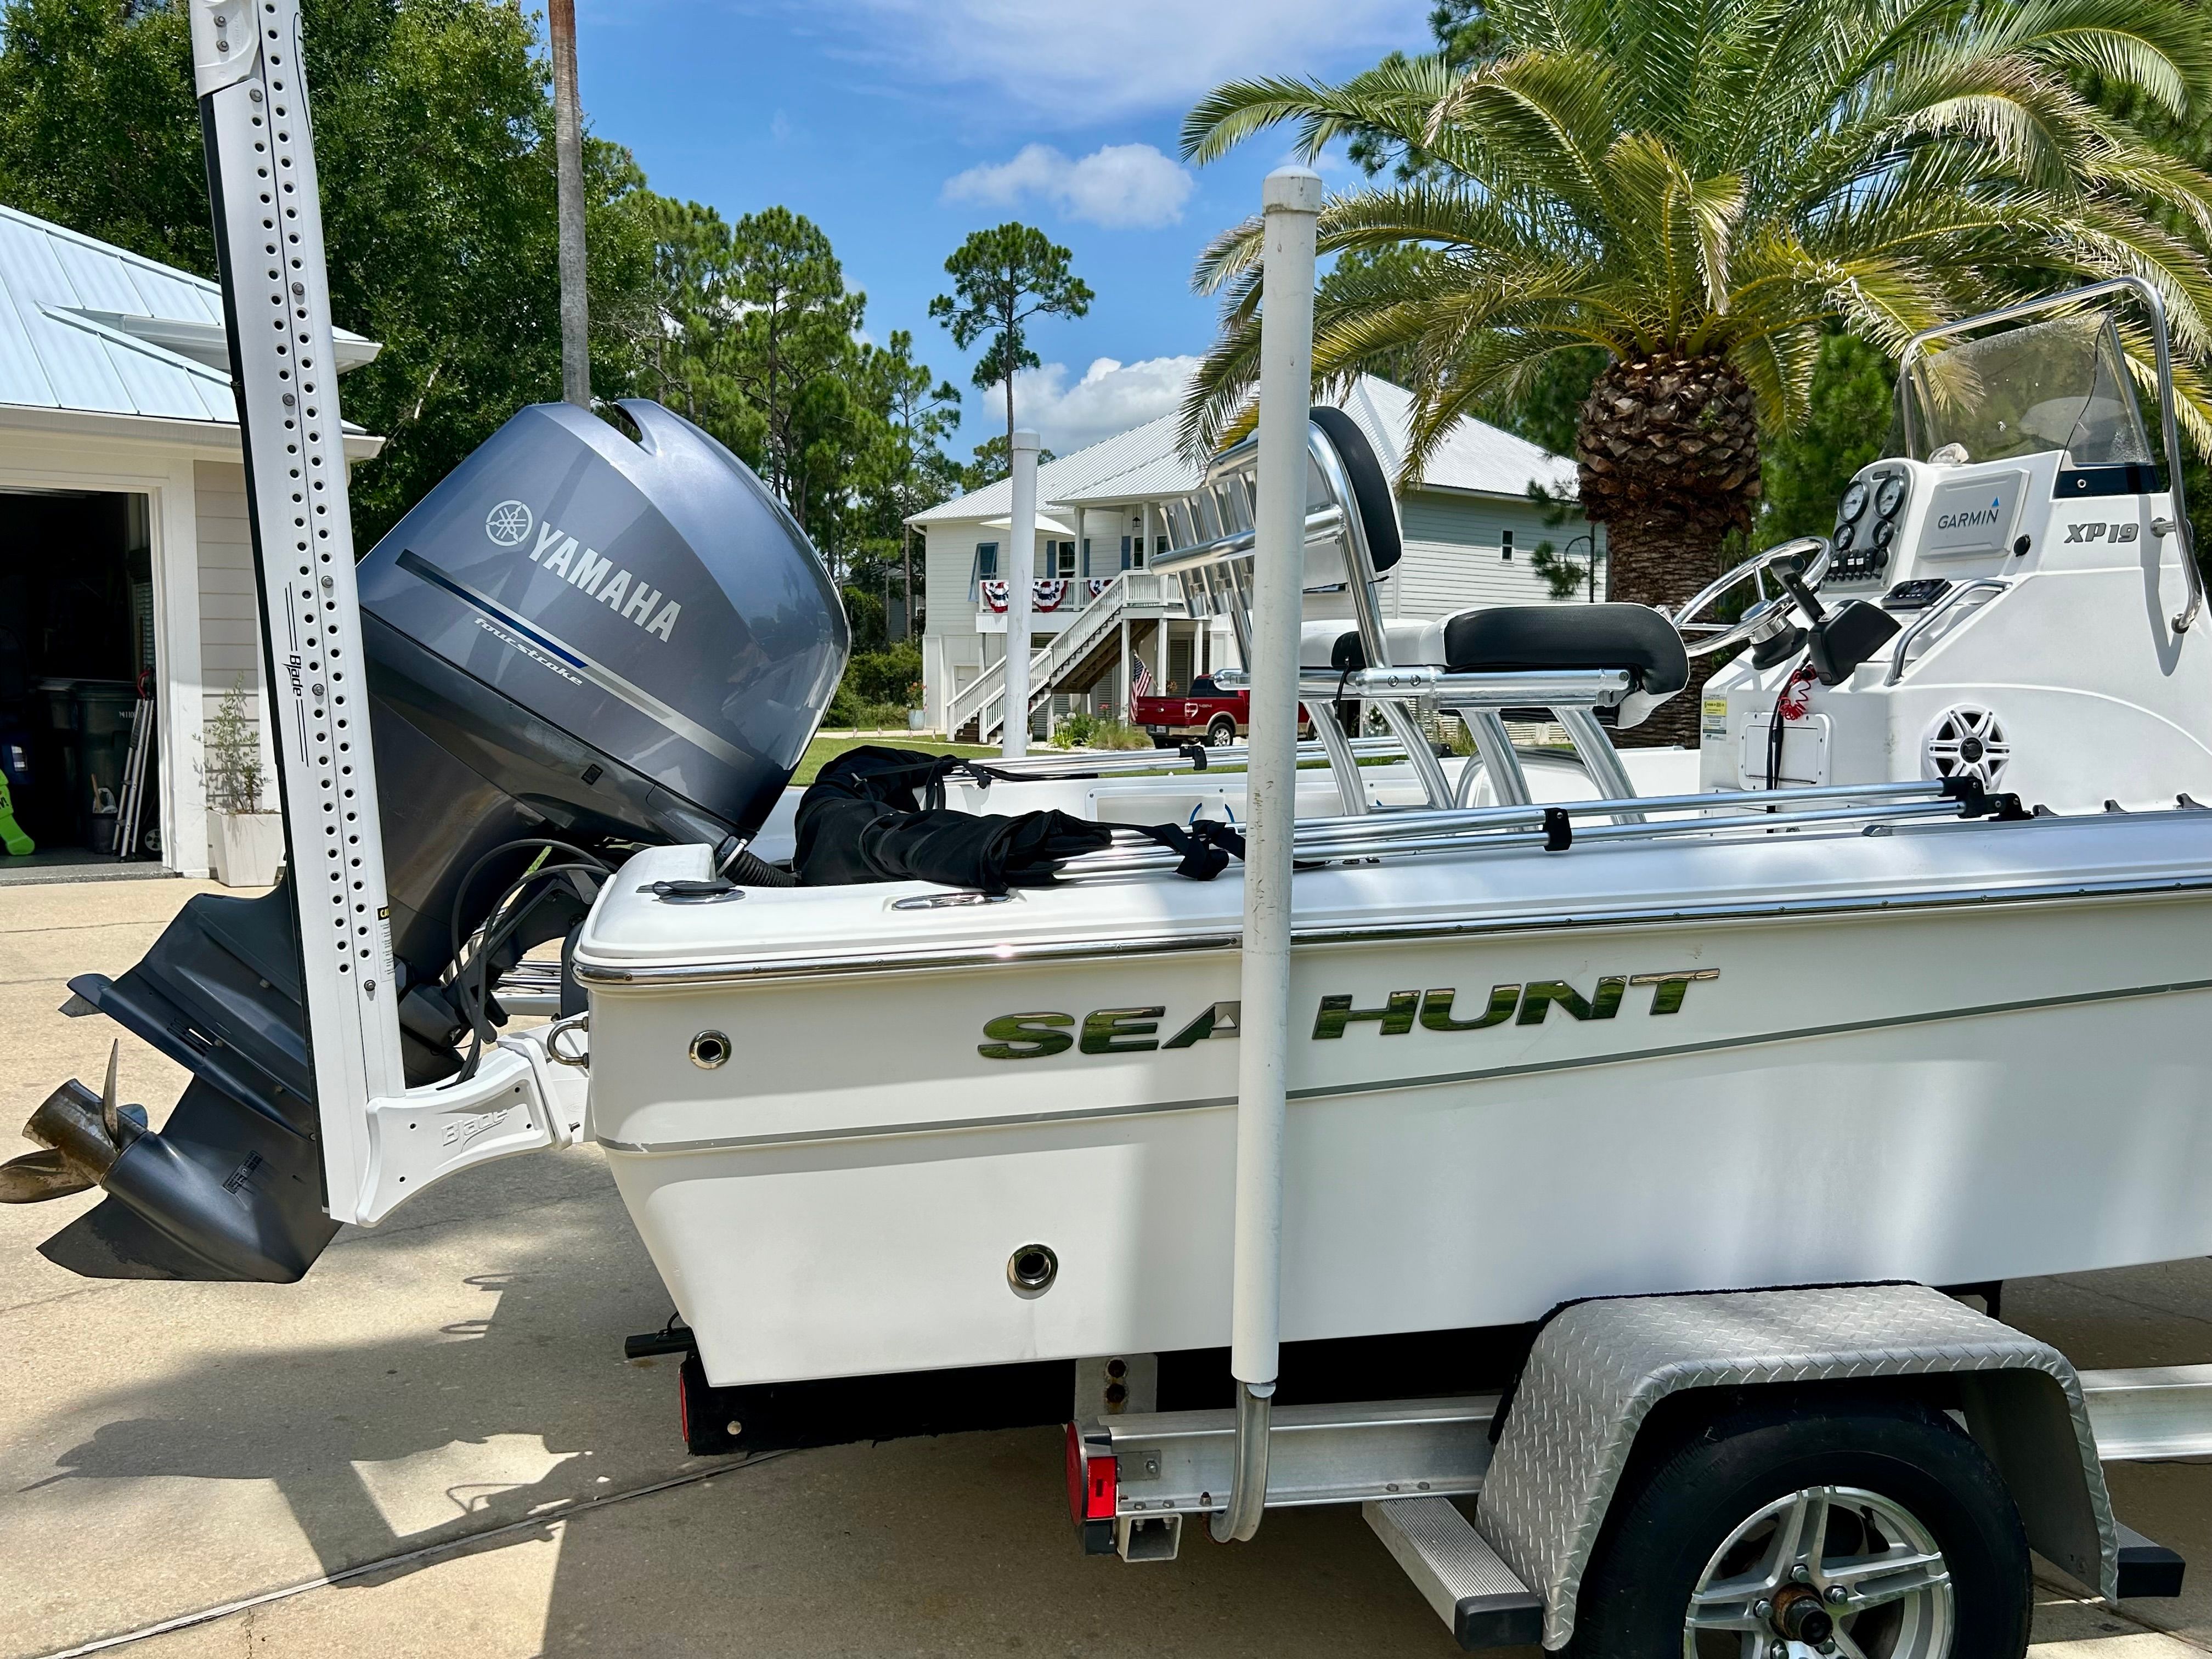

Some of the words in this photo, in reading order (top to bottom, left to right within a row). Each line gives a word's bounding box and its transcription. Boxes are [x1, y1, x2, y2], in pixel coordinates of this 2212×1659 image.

[1938, 509, 1999, 529] GARMIN
[528, 521, 681, 643] YAMAHA
[281, 654, 303, 696] Blade
[978, 1001, 1241, 1059] SEA
[1312, 968, 1720, 1040] HUNT
[441, 1109, 509, 1152] Blade
